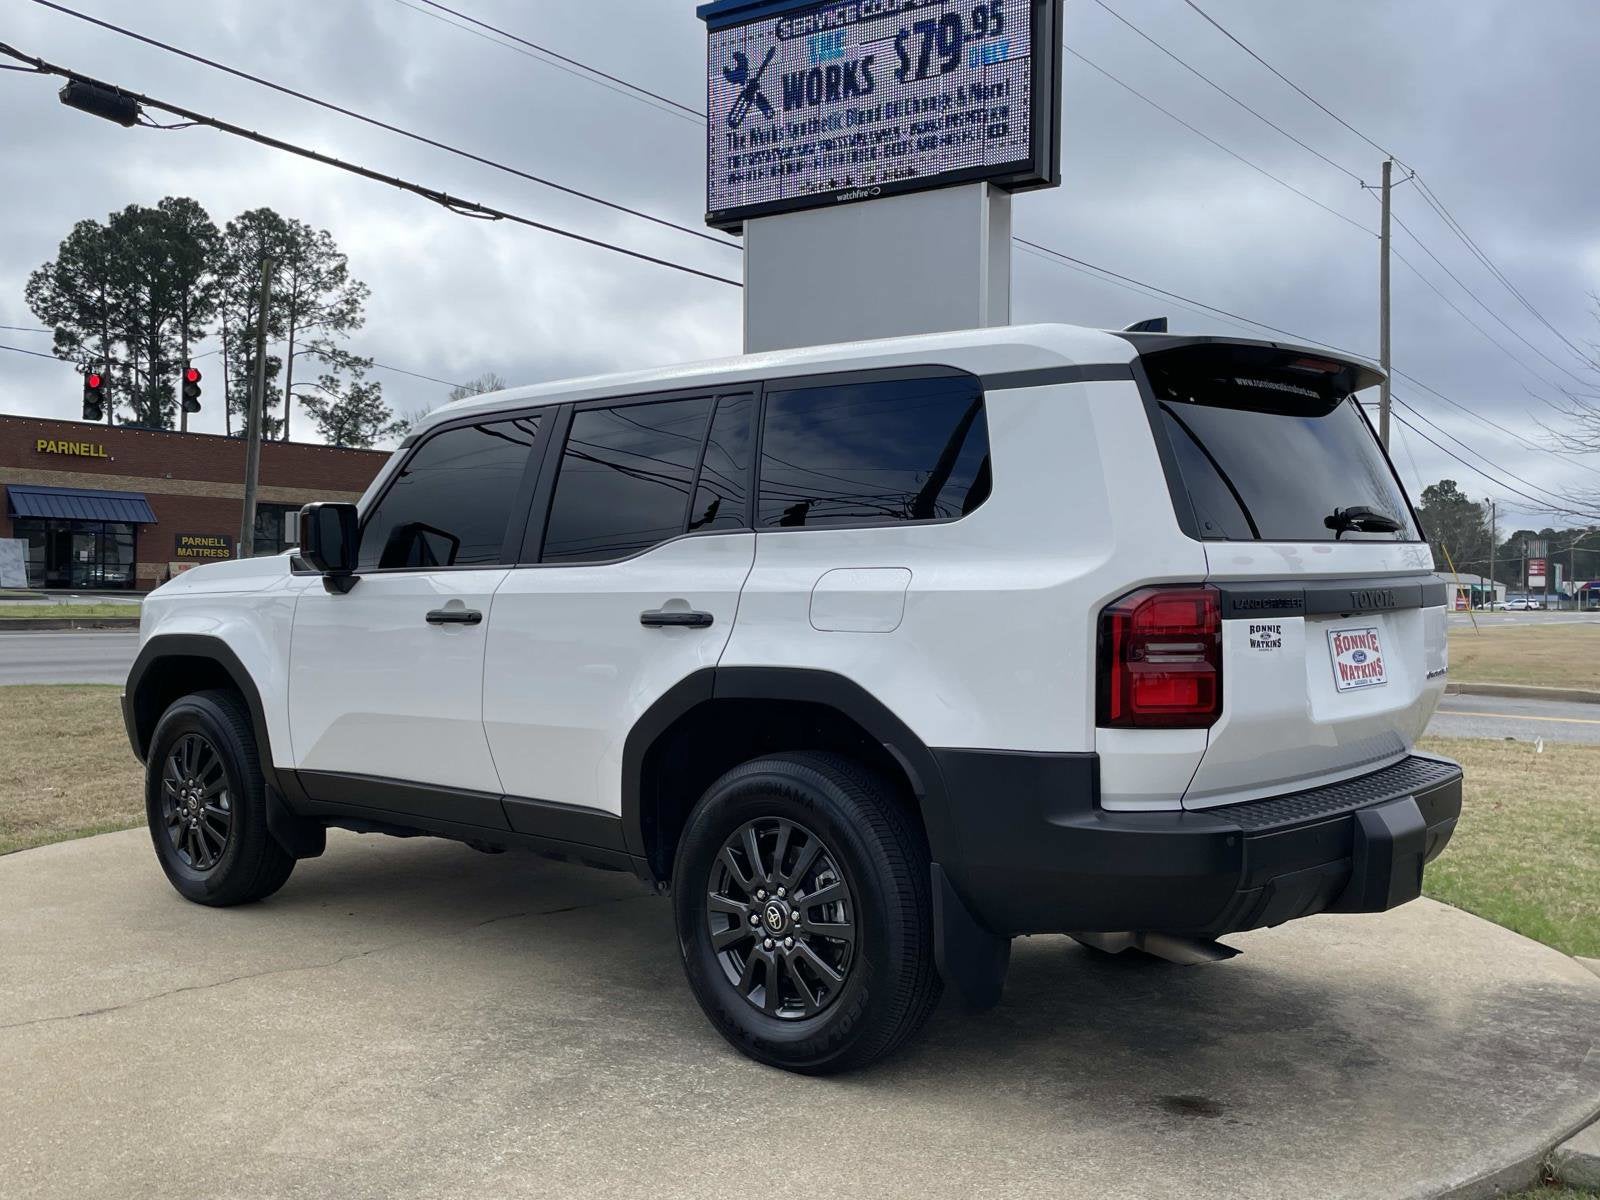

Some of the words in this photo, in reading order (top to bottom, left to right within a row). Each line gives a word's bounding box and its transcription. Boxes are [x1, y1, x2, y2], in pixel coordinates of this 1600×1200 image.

[808, 30, 846, 62] THE
[782, 55, 874, 111] WORKS
[727, 130, 745, 151] The
[837, 190, 868, 201] watchfire
[37, 439, 108, 457] PARNELL
[182, 536, 226, 547] PARNELL
[177, 547, 230, 558] MATTRESS
[1351, 589, 1395, 609] TOYOTA
[1249, 624, 1282, 635] RONNIE
[1249, 637, 1282, 649] WATKINS
[1334, 634, 1380, 657] RONNIE
[1338, 657, 1383, 682] WATKINS
